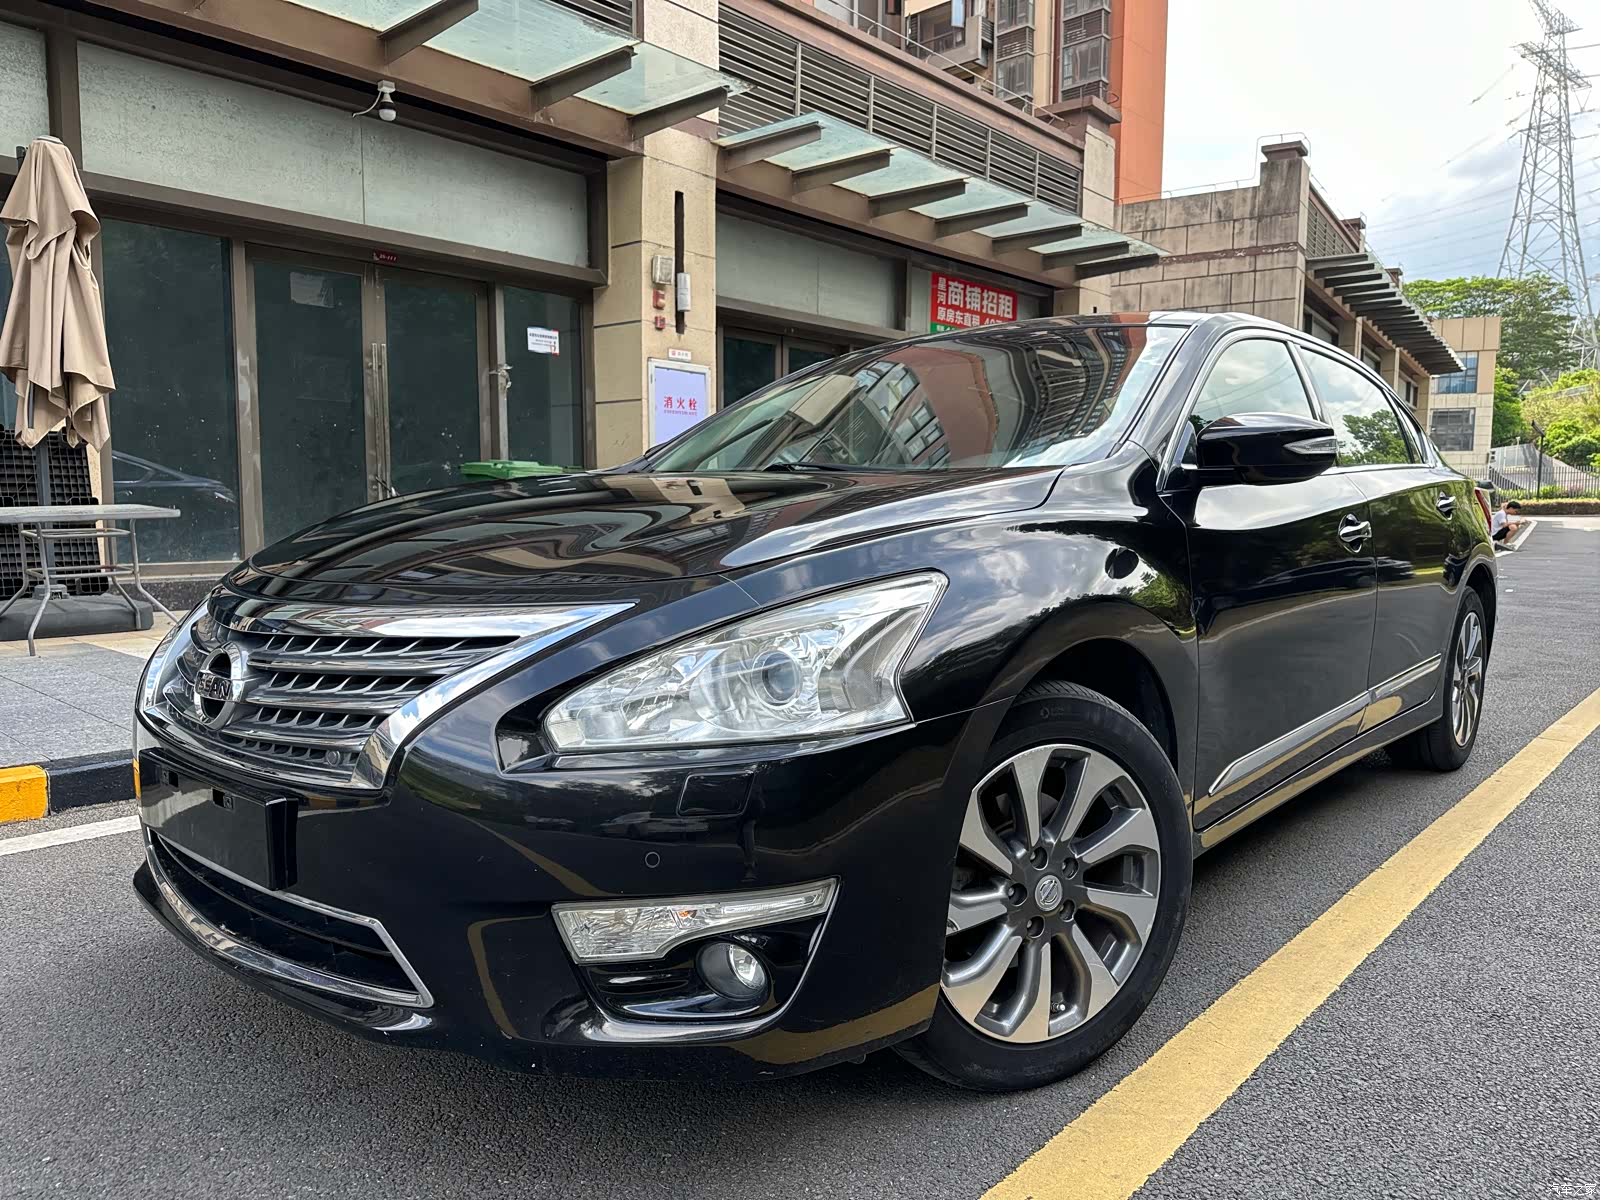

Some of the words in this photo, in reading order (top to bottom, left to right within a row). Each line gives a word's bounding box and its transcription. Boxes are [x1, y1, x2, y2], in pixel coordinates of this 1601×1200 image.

[948, 281, 1014, 319] 商铺招租
[663, 395, 697, 411] 消火栓
